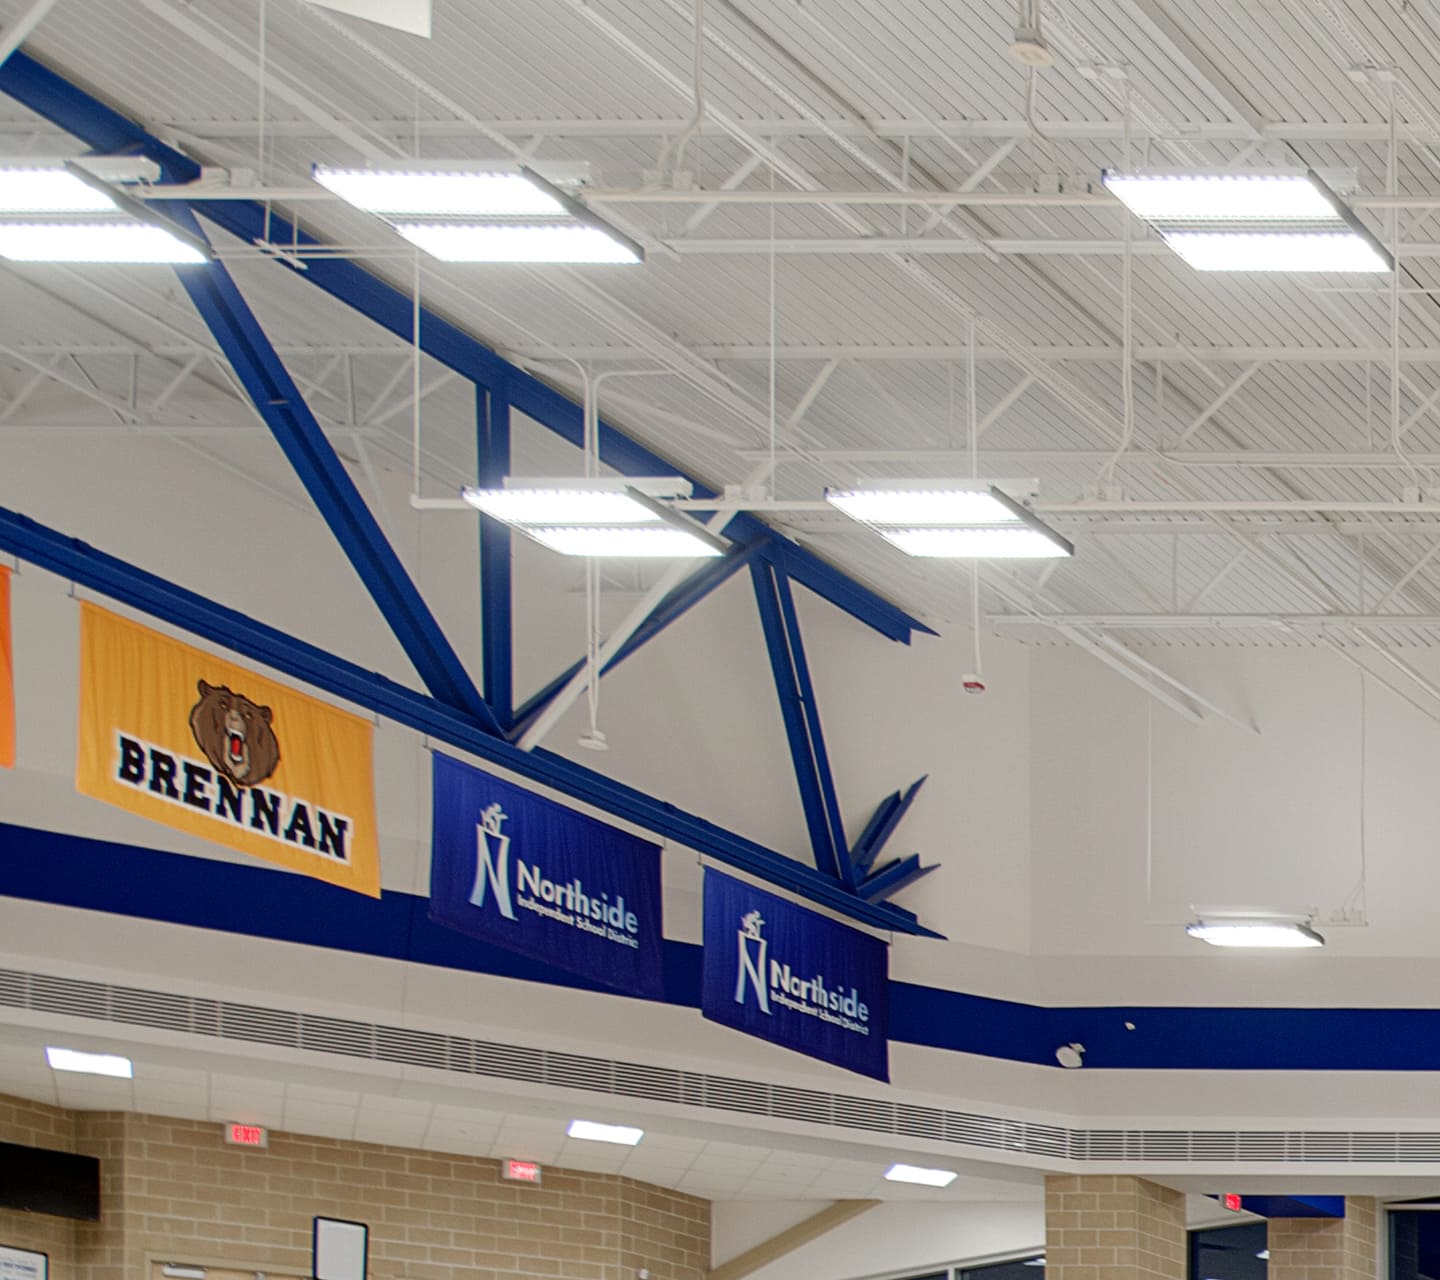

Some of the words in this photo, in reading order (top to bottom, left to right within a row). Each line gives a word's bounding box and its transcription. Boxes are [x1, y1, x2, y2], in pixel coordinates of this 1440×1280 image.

[117, 733, 350, 861] BRENNAN
[517, 859, 639, 934] Northside
[770, 959, 869, 1022] Northside
